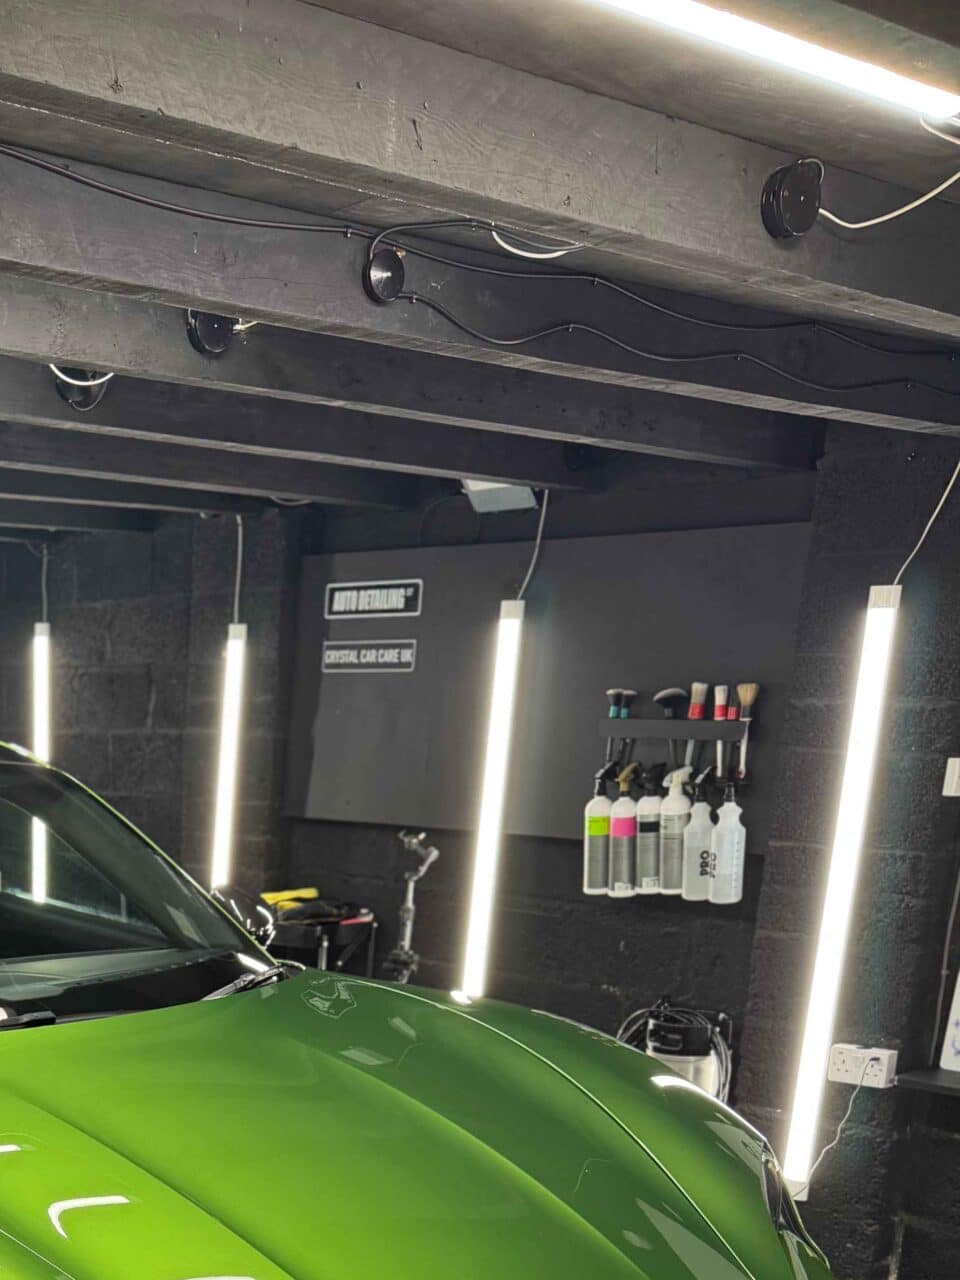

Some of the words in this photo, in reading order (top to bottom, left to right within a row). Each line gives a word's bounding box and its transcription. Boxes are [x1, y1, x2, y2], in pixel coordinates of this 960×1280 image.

[332, 590, 358, 612] AUTO
[357, 587, 406, 611] DETAILING
[324, 649, 358, 664] CRYSTAL
[360, 648, 378, 663] CAR
[378, 648, 400, 663] CARE
[400, 647, 413, 662] UK
